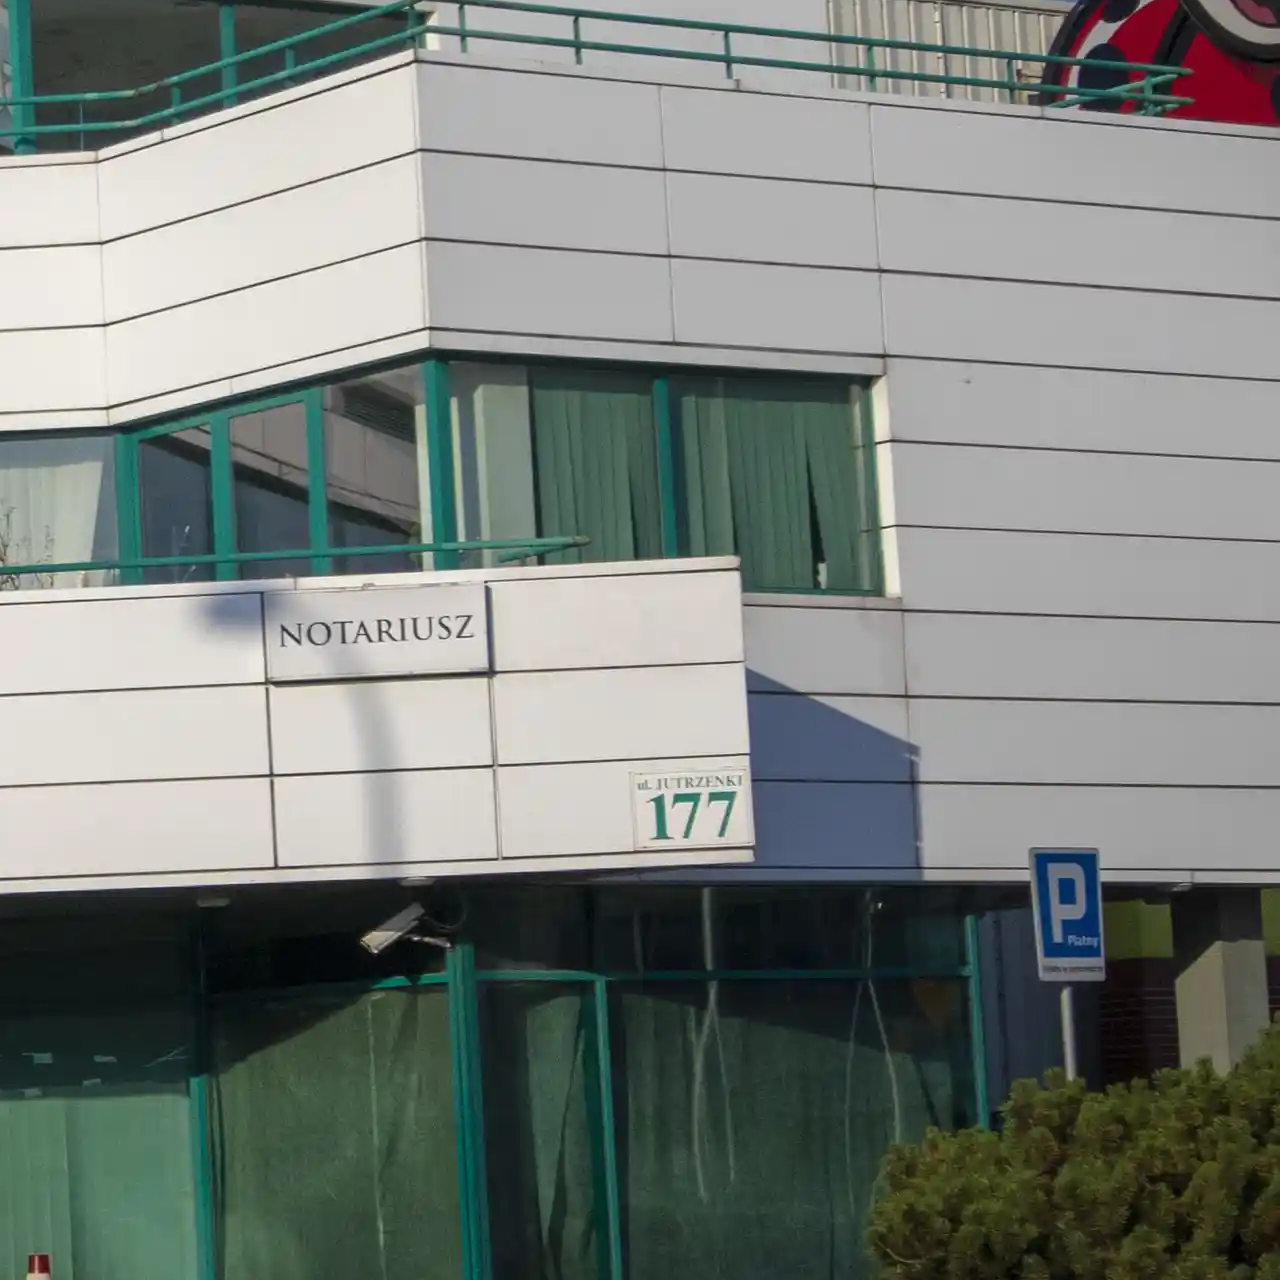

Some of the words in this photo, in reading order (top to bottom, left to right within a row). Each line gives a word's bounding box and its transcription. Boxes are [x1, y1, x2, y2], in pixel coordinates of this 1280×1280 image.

[279, 614, 475, 648] NOTARIUSZ
[655, 775, 743, 791] JUTRZENKI
[646, 790, 737, 841] 177
[1047, 862, 1087, 943] P
